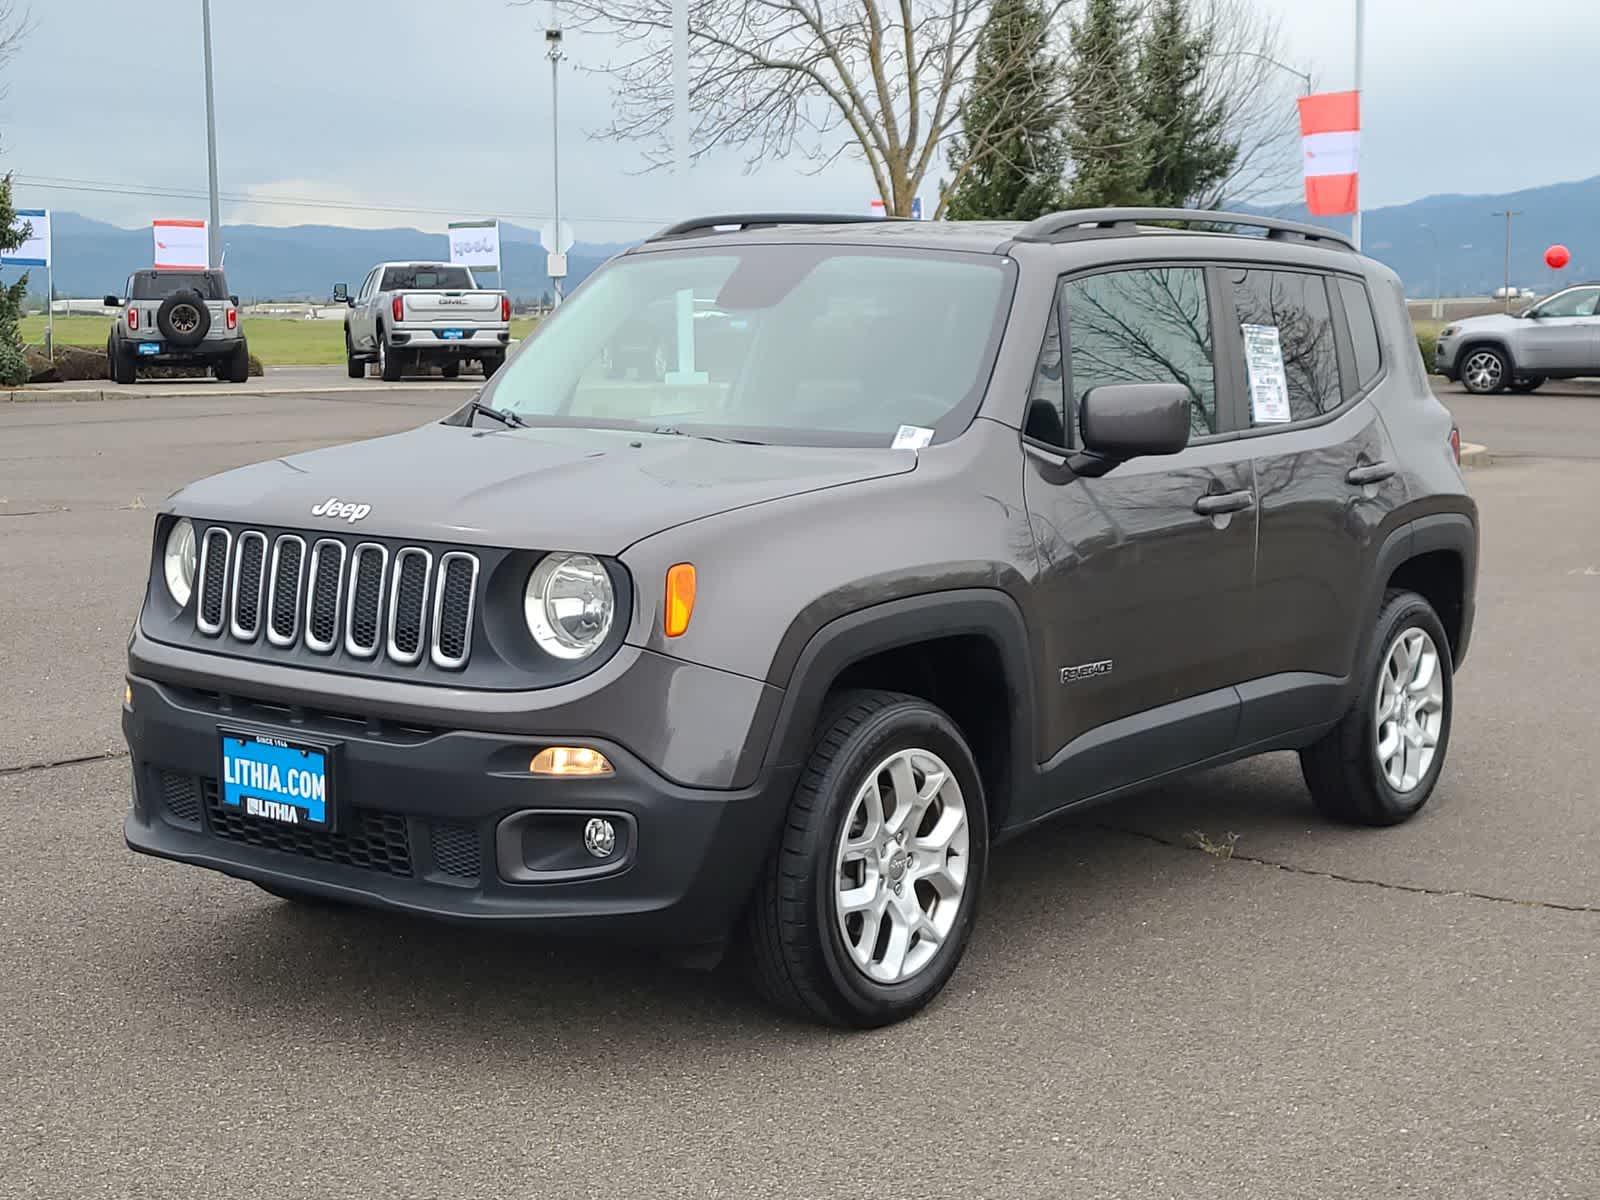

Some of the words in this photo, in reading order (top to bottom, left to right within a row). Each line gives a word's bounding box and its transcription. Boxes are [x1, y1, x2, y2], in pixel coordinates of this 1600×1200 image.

[311, 497, 371, 524] Jeep
[1060, 659, 1113, 684] RENEGADE
[223, 756, 326, 803] LITHIA.COM
[258, 799, 299, 824] LITHIA
